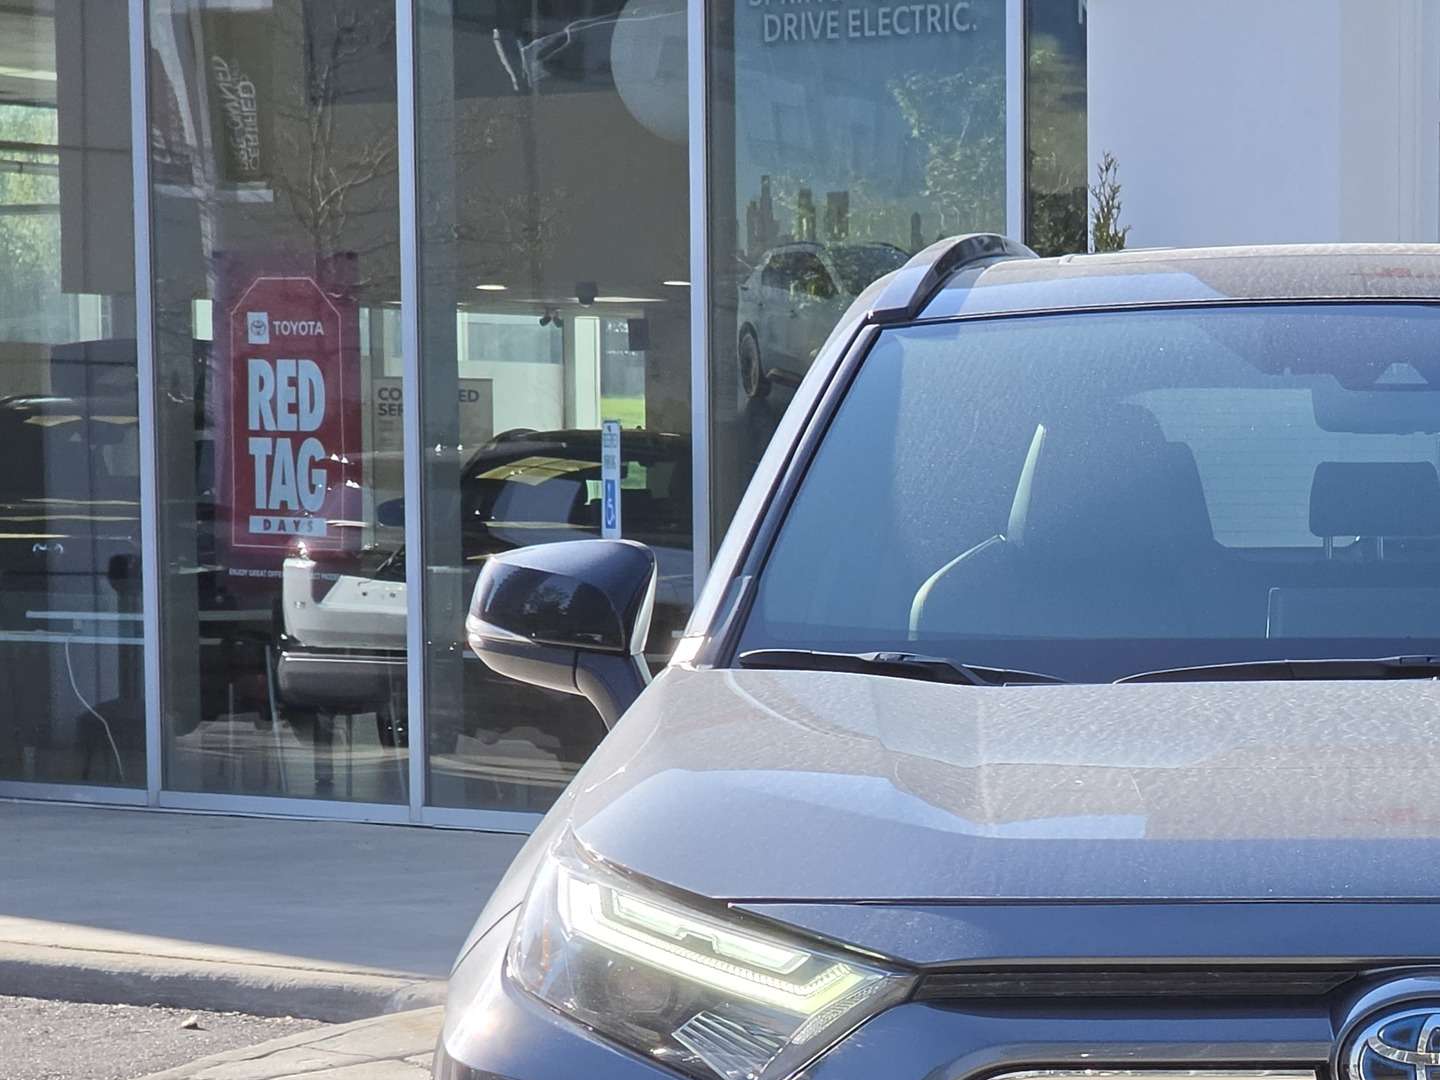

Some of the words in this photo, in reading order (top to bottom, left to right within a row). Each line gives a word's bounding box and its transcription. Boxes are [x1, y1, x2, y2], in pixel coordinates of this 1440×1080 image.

[763, 10, 840, 42] DRIVE
[847, 2, 977, 38] ELECTRIC.
[273, 320, 325, 336] TOYOTA
[247, 358, 326, 432] RED
[248, 437, 328, 512] TAG
[263, 518, 314, 532] DAYS
